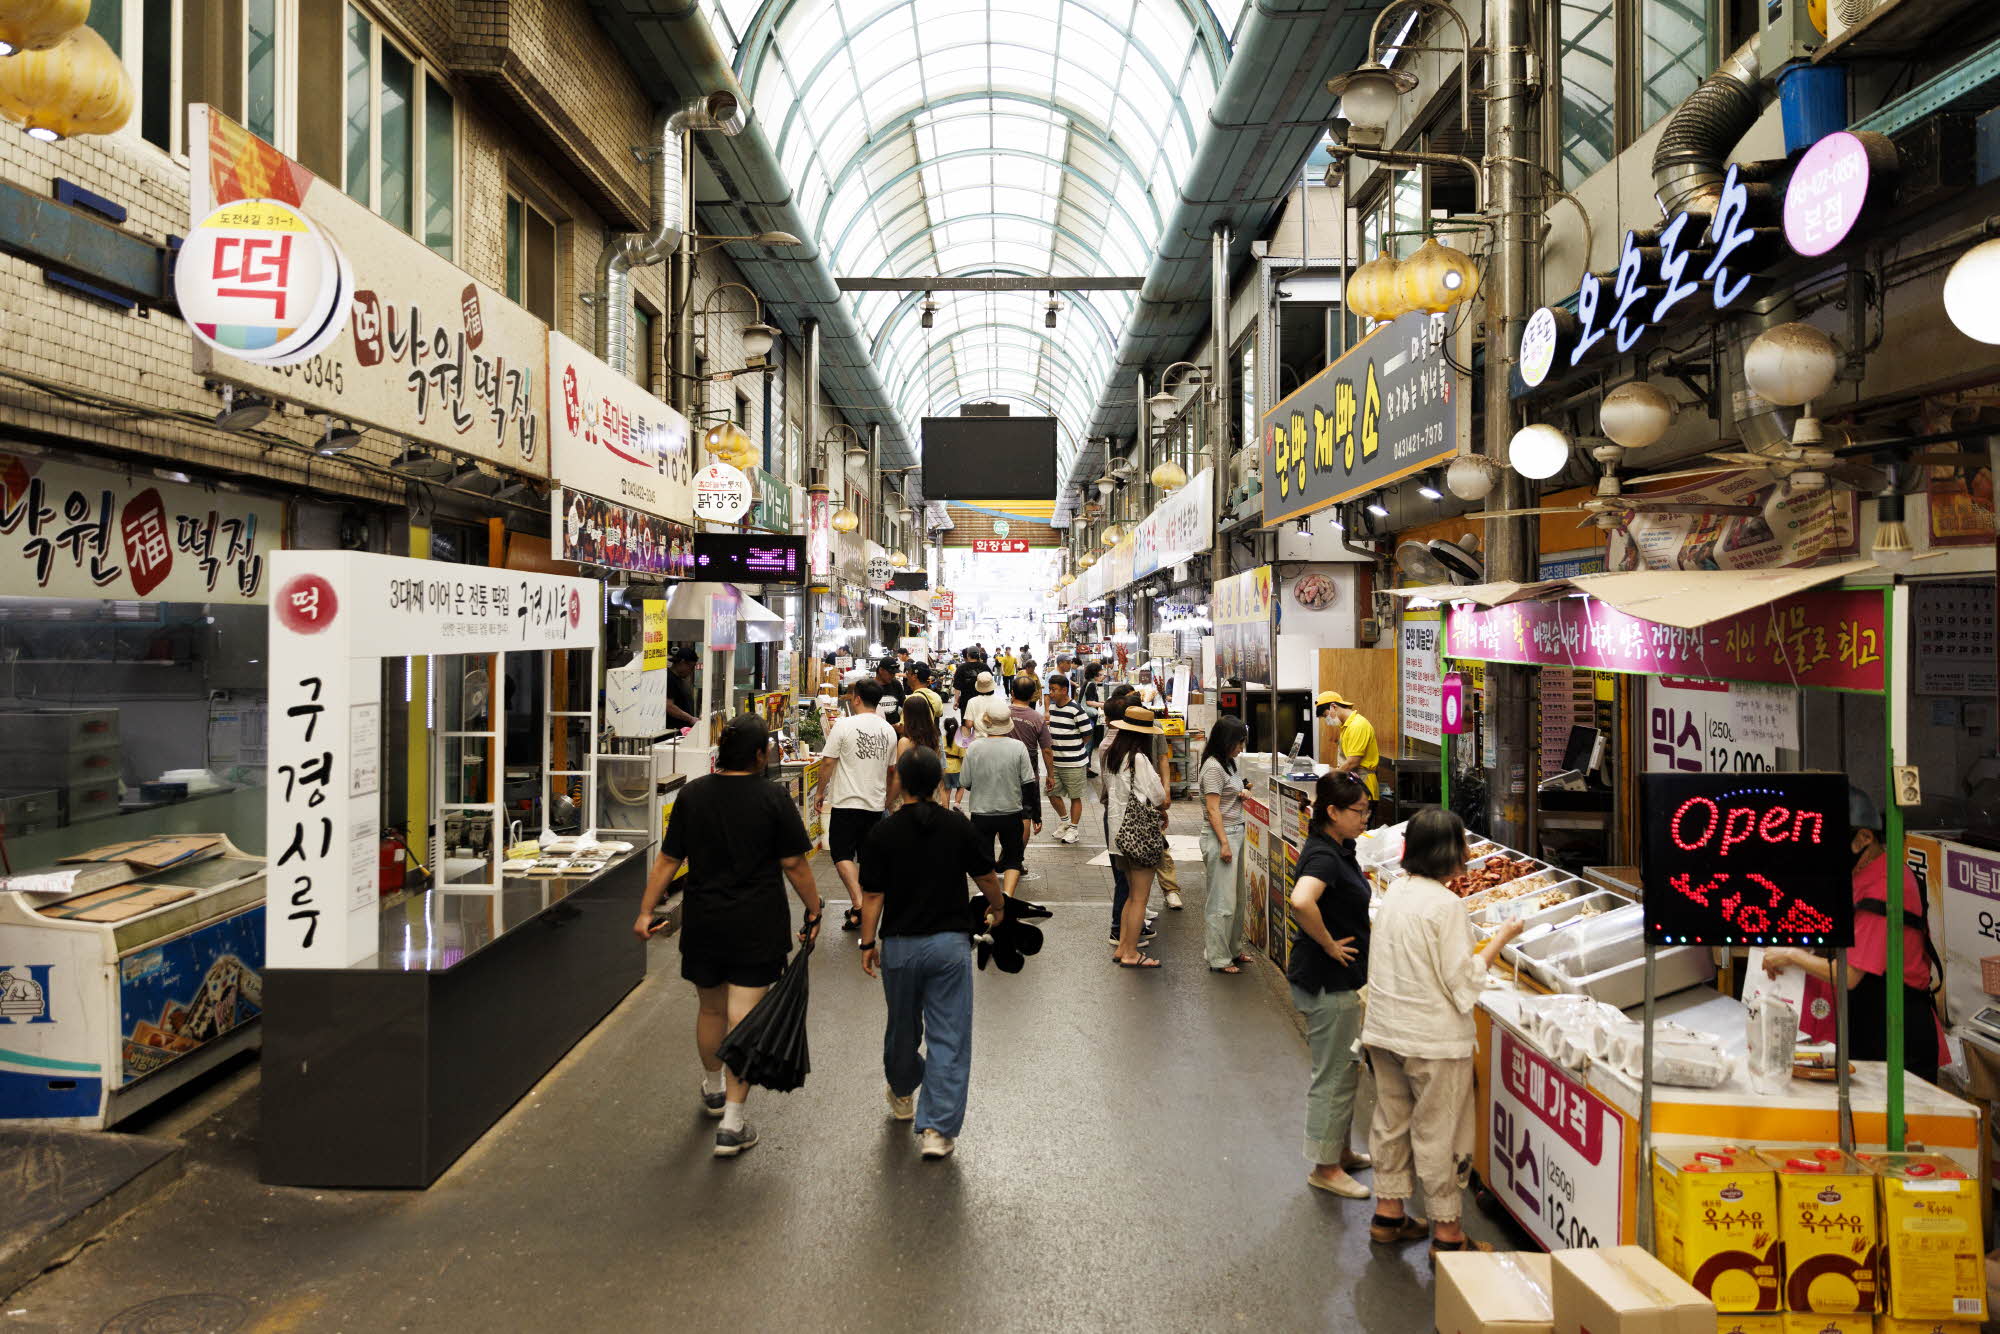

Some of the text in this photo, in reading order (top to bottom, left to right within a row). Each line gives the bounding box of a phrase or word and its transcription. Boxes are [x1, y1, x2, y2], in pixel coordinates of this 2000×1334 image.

[267, 215, 294, 226] 31-1
[1805, 193, 1843, 242] 본점
[212, 235, 293, 319] 떡
[698, 493, 742, 509] 닭강정
[176, 510, 264, 597] 떡집
[976, 541, 1011, 551] 화장실
[290, 586, 320, 620] 떡
[390, 579, 424, 614] 3대째
[429, 581, 450, 614] 이어
[455, 582, 466, 615] 온
[469, 583, 488, 617] 전통
[492, 584, 509, 616] 떡집
[518, 581, 568, 640] 구경시루
[1652, 622, 1705, 661] 건강간식
[1726, 620, 1756, 663] 지인
[1765, 606, 1831, 674] 선물로
[1837, 620, 1881, 669] 최고
[1652, 708, 1702, 772] 믹스
[277, 676, 333, 949] 구경시루
[1671, 797, 1823, 856] Open
[1511, 1047, 1588, 1147] 판매가격
[1494, 1100, 1541, 1216] 믹스
[1546, 1155, 1575, 1203] (250g)
[1702, 1208, 1764, 1231] 옥수수유
[1798, 1210, 1864, 1234] 옥수수유
